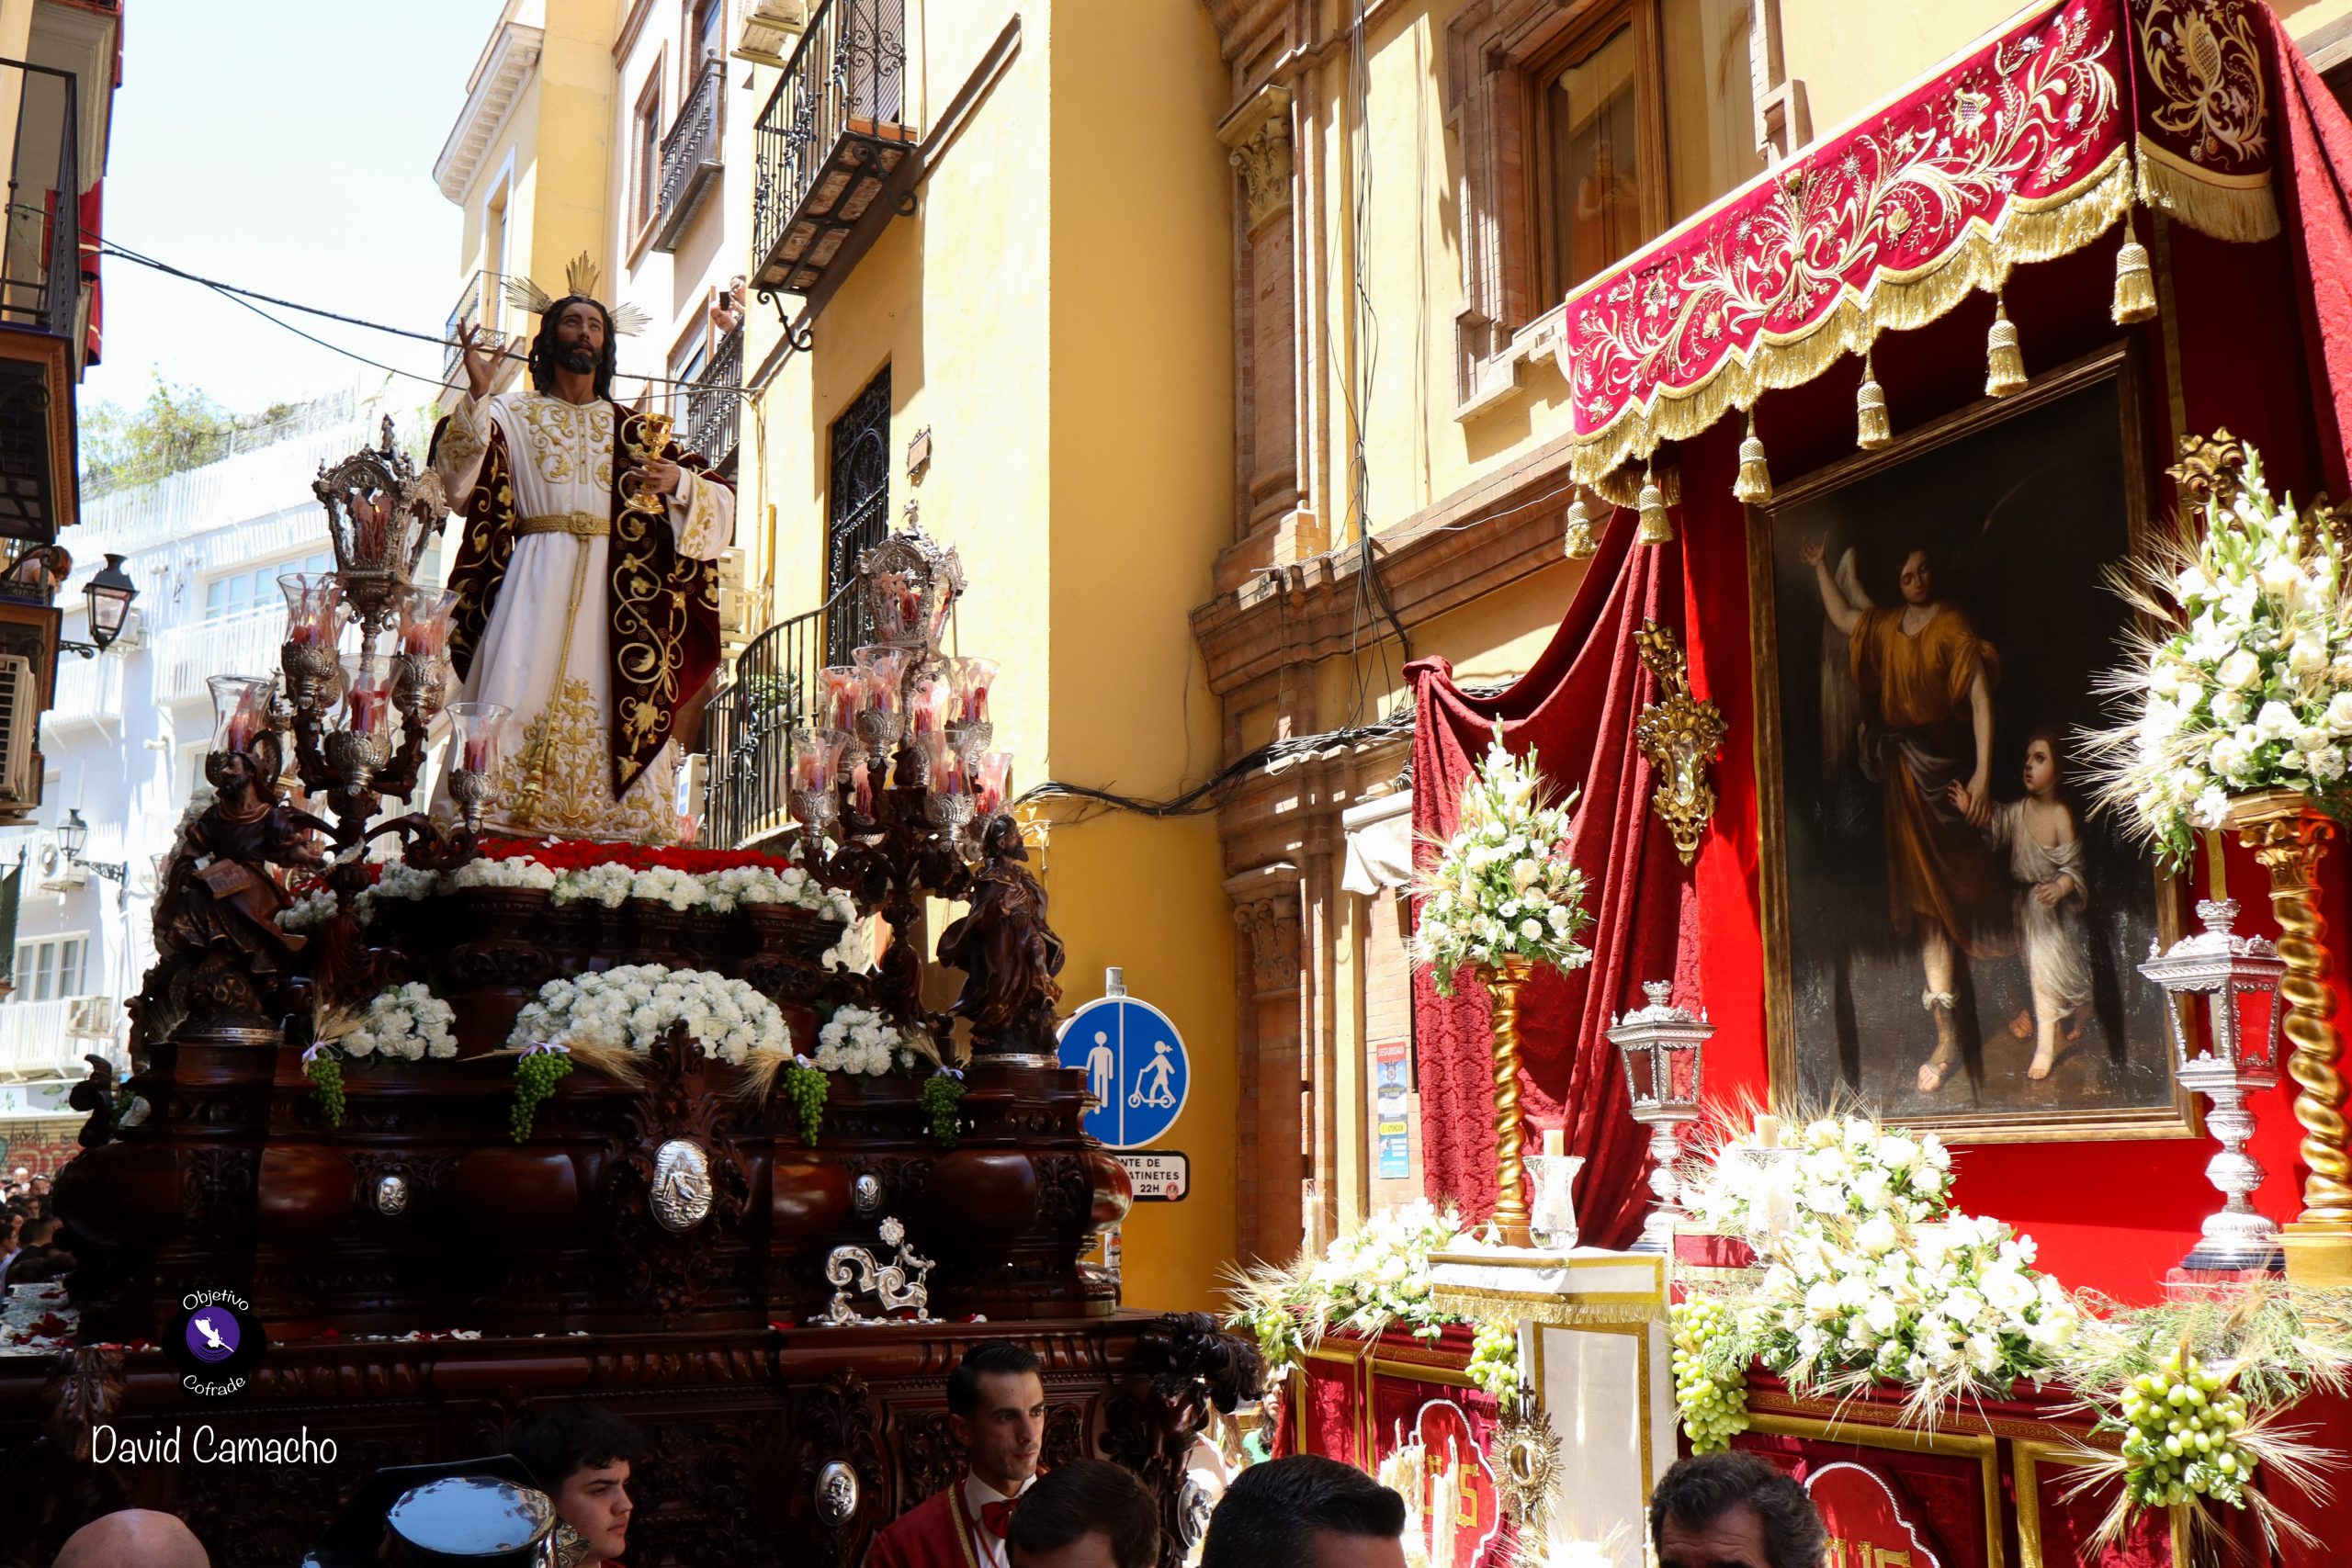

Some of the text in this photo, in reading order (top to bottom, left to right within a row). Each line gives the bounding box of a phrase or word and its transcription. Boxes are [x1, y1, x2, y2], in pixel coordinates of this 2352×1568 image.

[1377, 1045, 1405, 1056] SEGURIDAD
[1120, 1158, 1160, 1168] NTE DE
[1128, 1171, 1180, 1180] ATINETES
[1139, 1184, 1159, 1192] 22H
